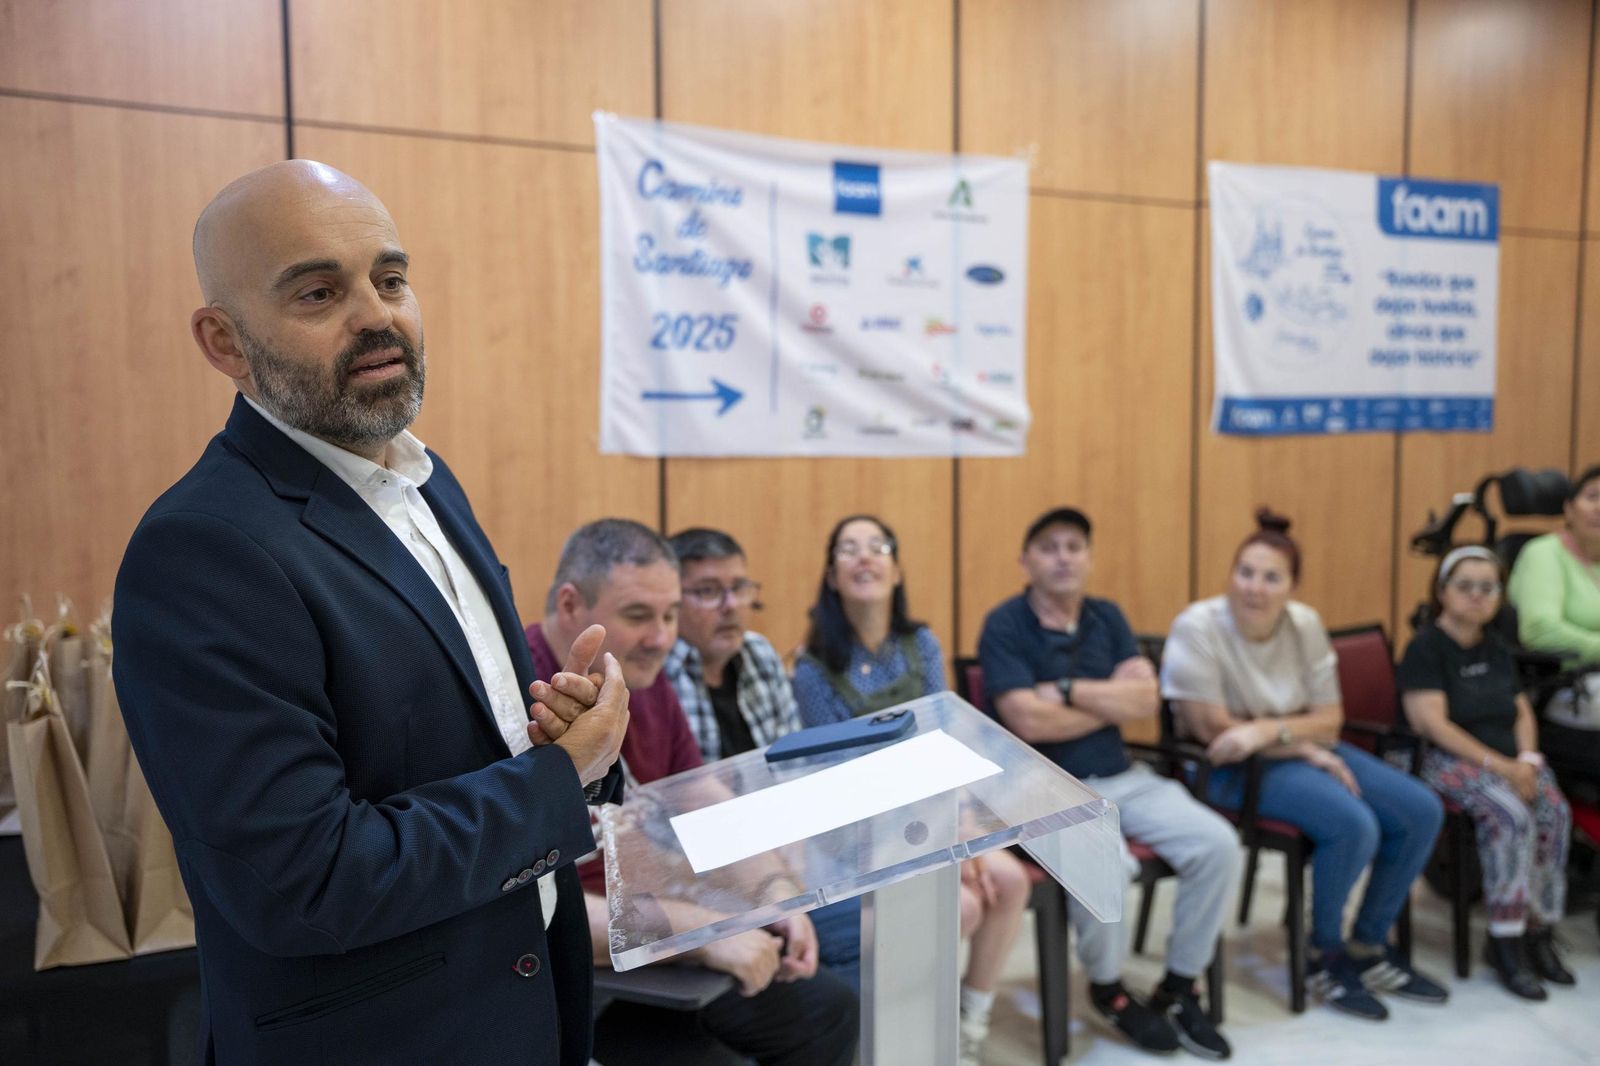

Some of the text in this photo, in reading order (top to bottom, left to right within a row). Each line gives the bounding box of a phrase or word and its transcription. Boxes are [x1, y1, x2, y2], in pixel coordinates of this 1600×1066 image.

[637, 158, 743, 206] Camino
[677, 208, 708, 239] de
[1392, 183, 1487, 236] faam
[634, 232, 753, 286] Santiago
[650, 312, 739, 352] 2025
